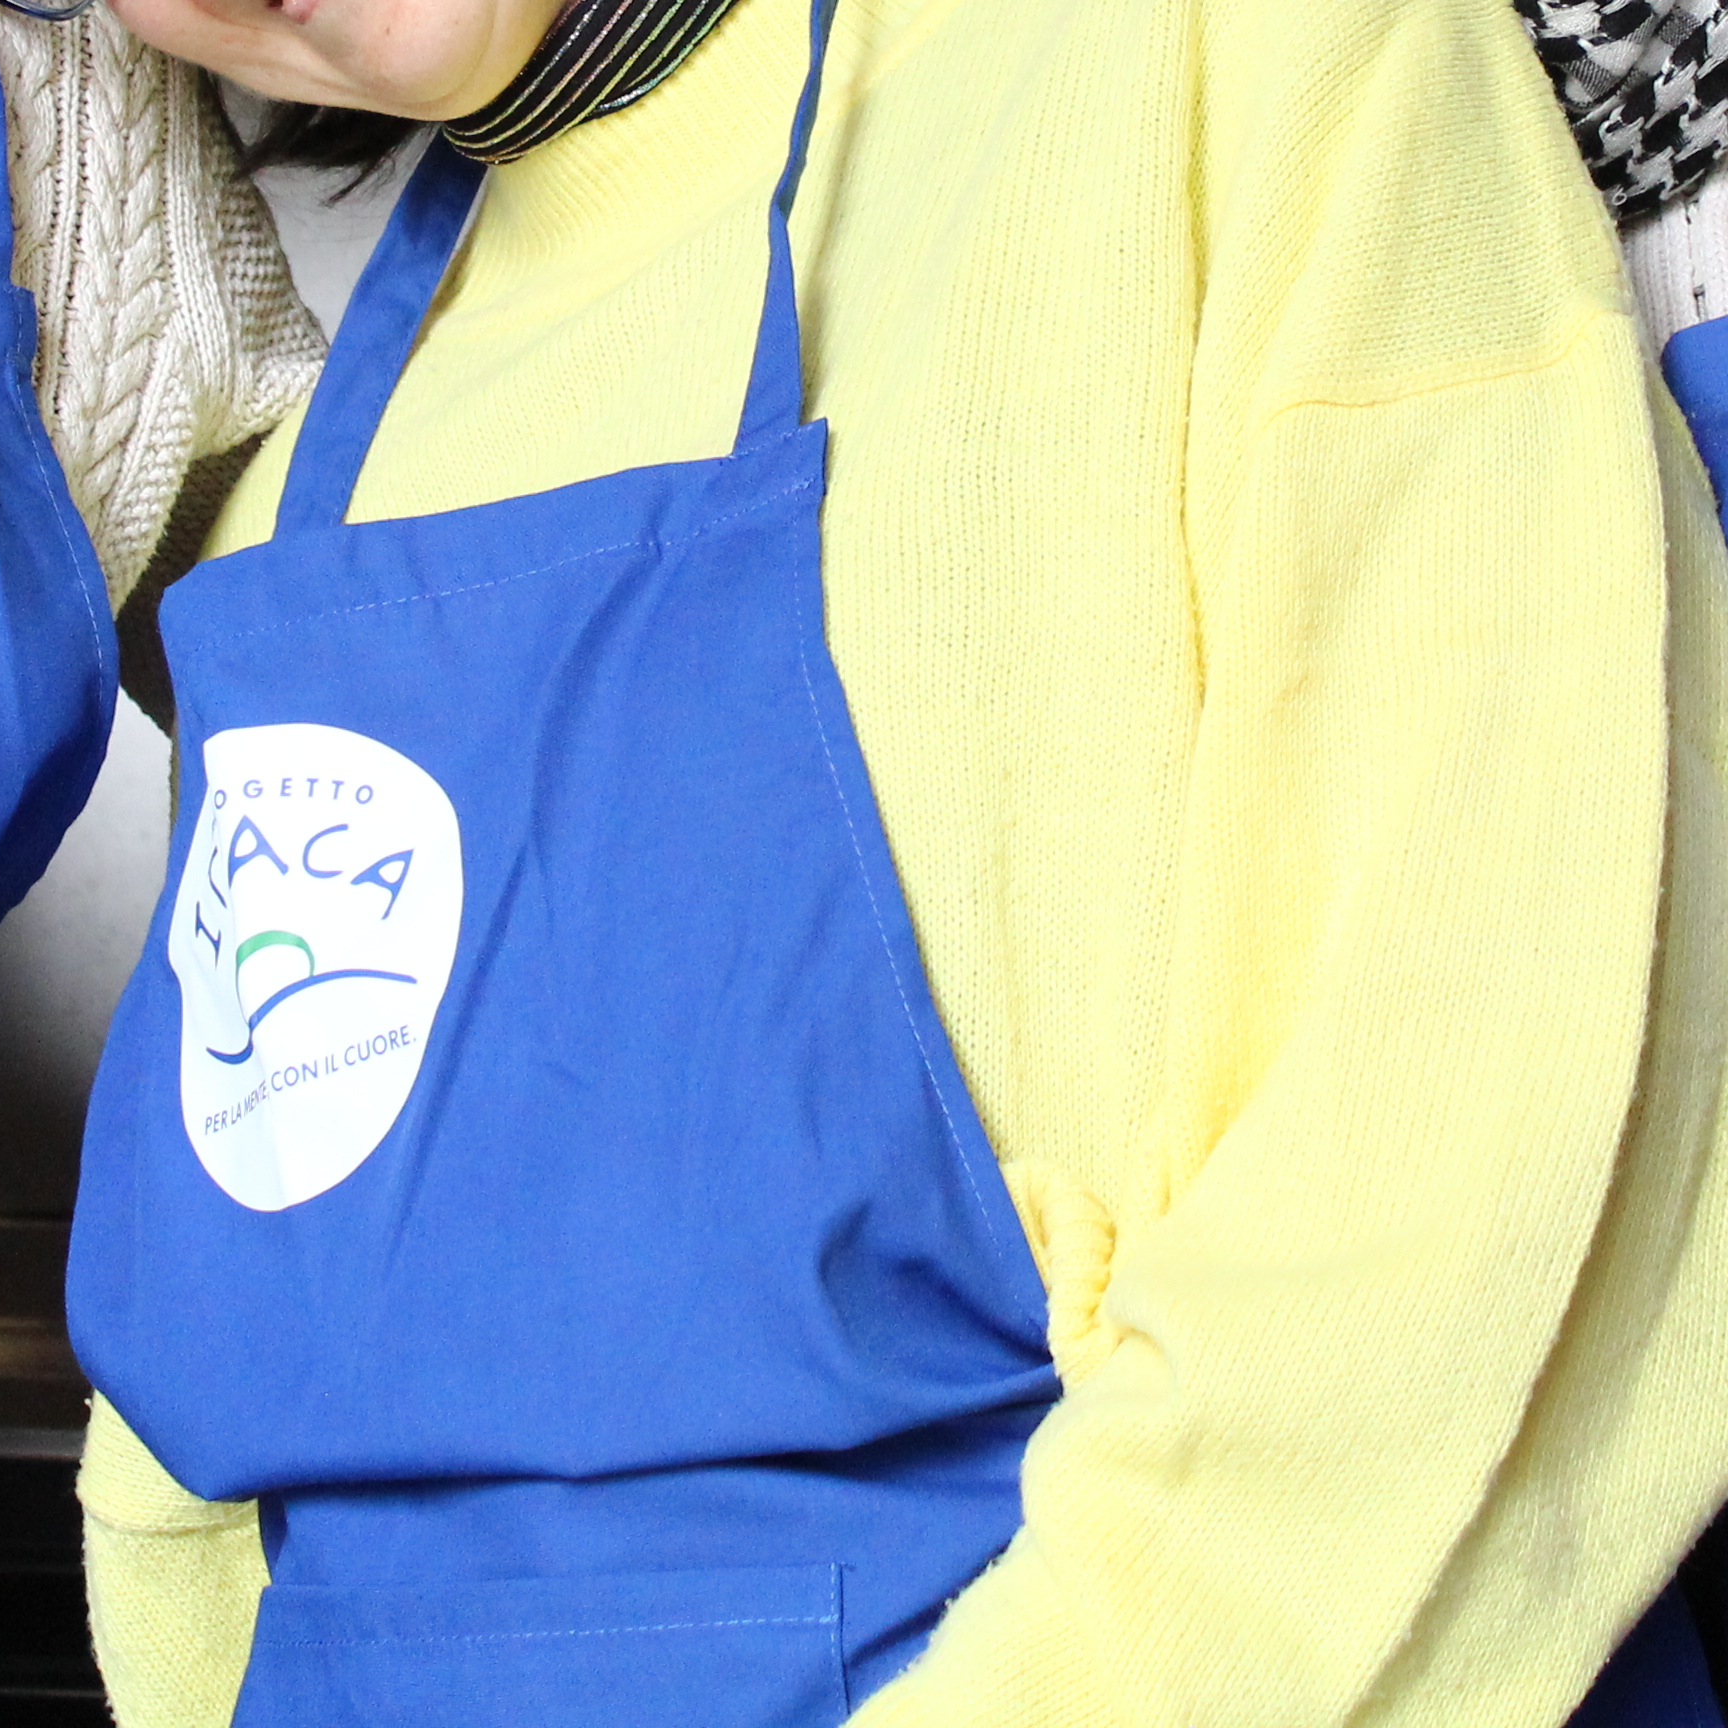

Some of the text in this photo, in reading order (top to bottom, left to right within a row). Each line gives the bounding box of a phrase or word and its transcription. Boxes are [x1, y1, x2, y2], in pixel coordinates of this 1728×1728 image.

[213, 776, 374, 811] OGETTO
[204, 1110, 229, 1136] PER
[230, 1101, 243, 1126] LA
[270, 1059, 319, 1092] CON
[324, 1053, 340, 1076] IL
[343, 1024, 418, 1066] CUORE.
